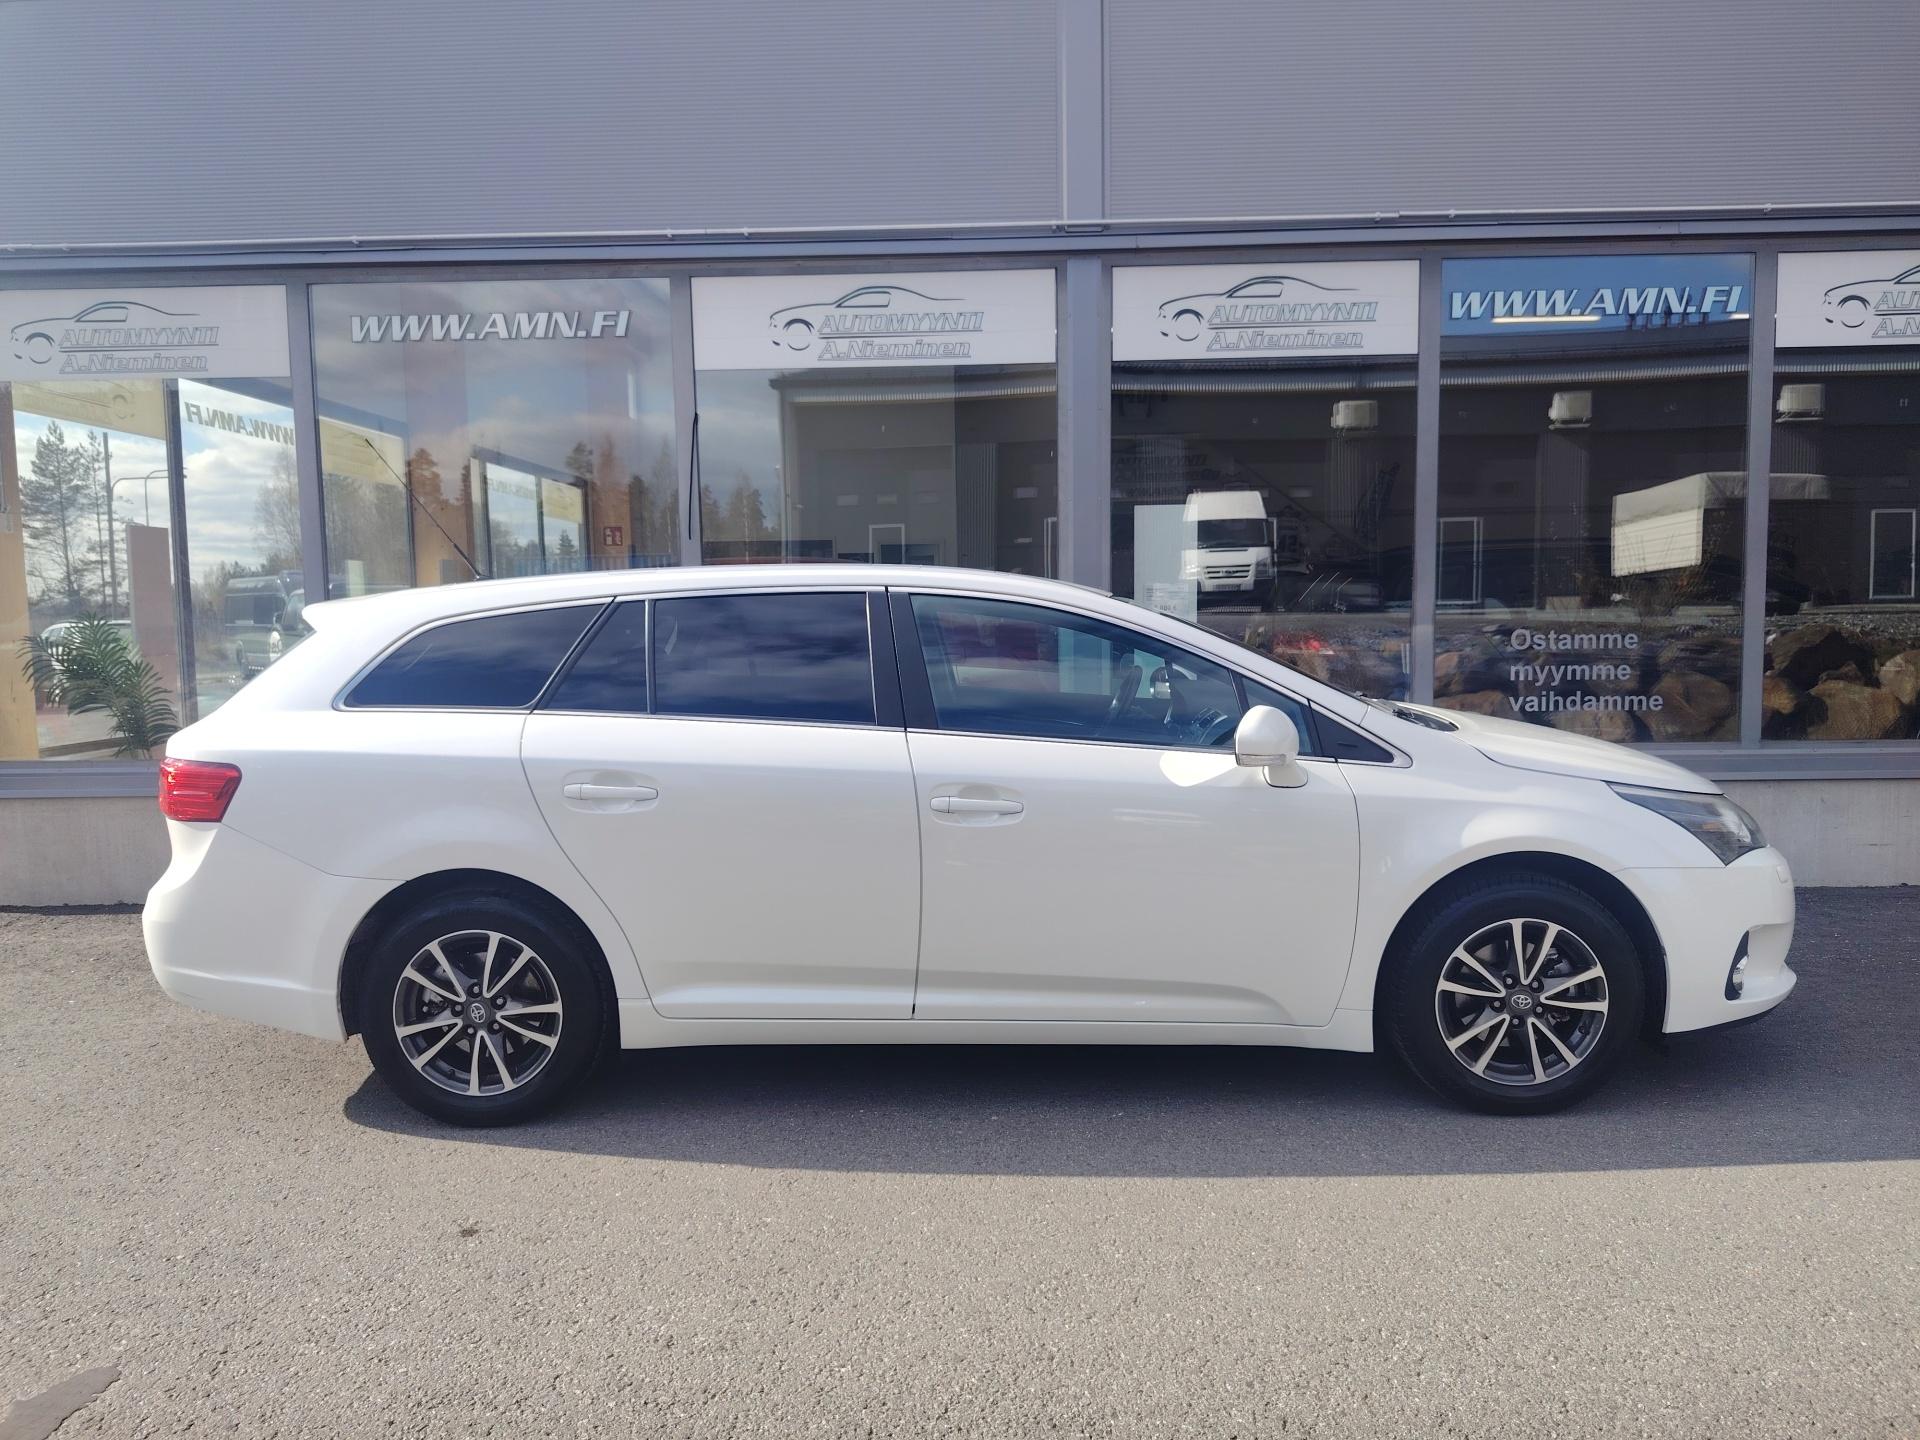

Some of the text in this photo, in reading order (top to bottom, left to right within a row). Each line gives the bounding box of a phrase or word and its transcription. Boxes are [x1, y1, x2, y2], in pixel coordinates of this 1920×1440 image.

[1207, 301, 1379, 323] AUTOMYYNTI
[1450, 285, 1744, 320] WWW.AMN.FI
[350, 310, 630, 343] WWW.AMN.FI
[817, 312, 984, 332] AUTOMYYNTI
[58, 326, 220, 346] AUTOMYYNTI
[1207, 330, 1363, 351] A.Nieminen
[818, 339, 971, 359] A.Nieminen
[59, 353, 208, 373] A.Nieminen
[1509, 628, 1639, 651] Ostamme
[1509, 661, 1632, 687] myymme
[1509, 690, 1664, 712] vaihdamme
